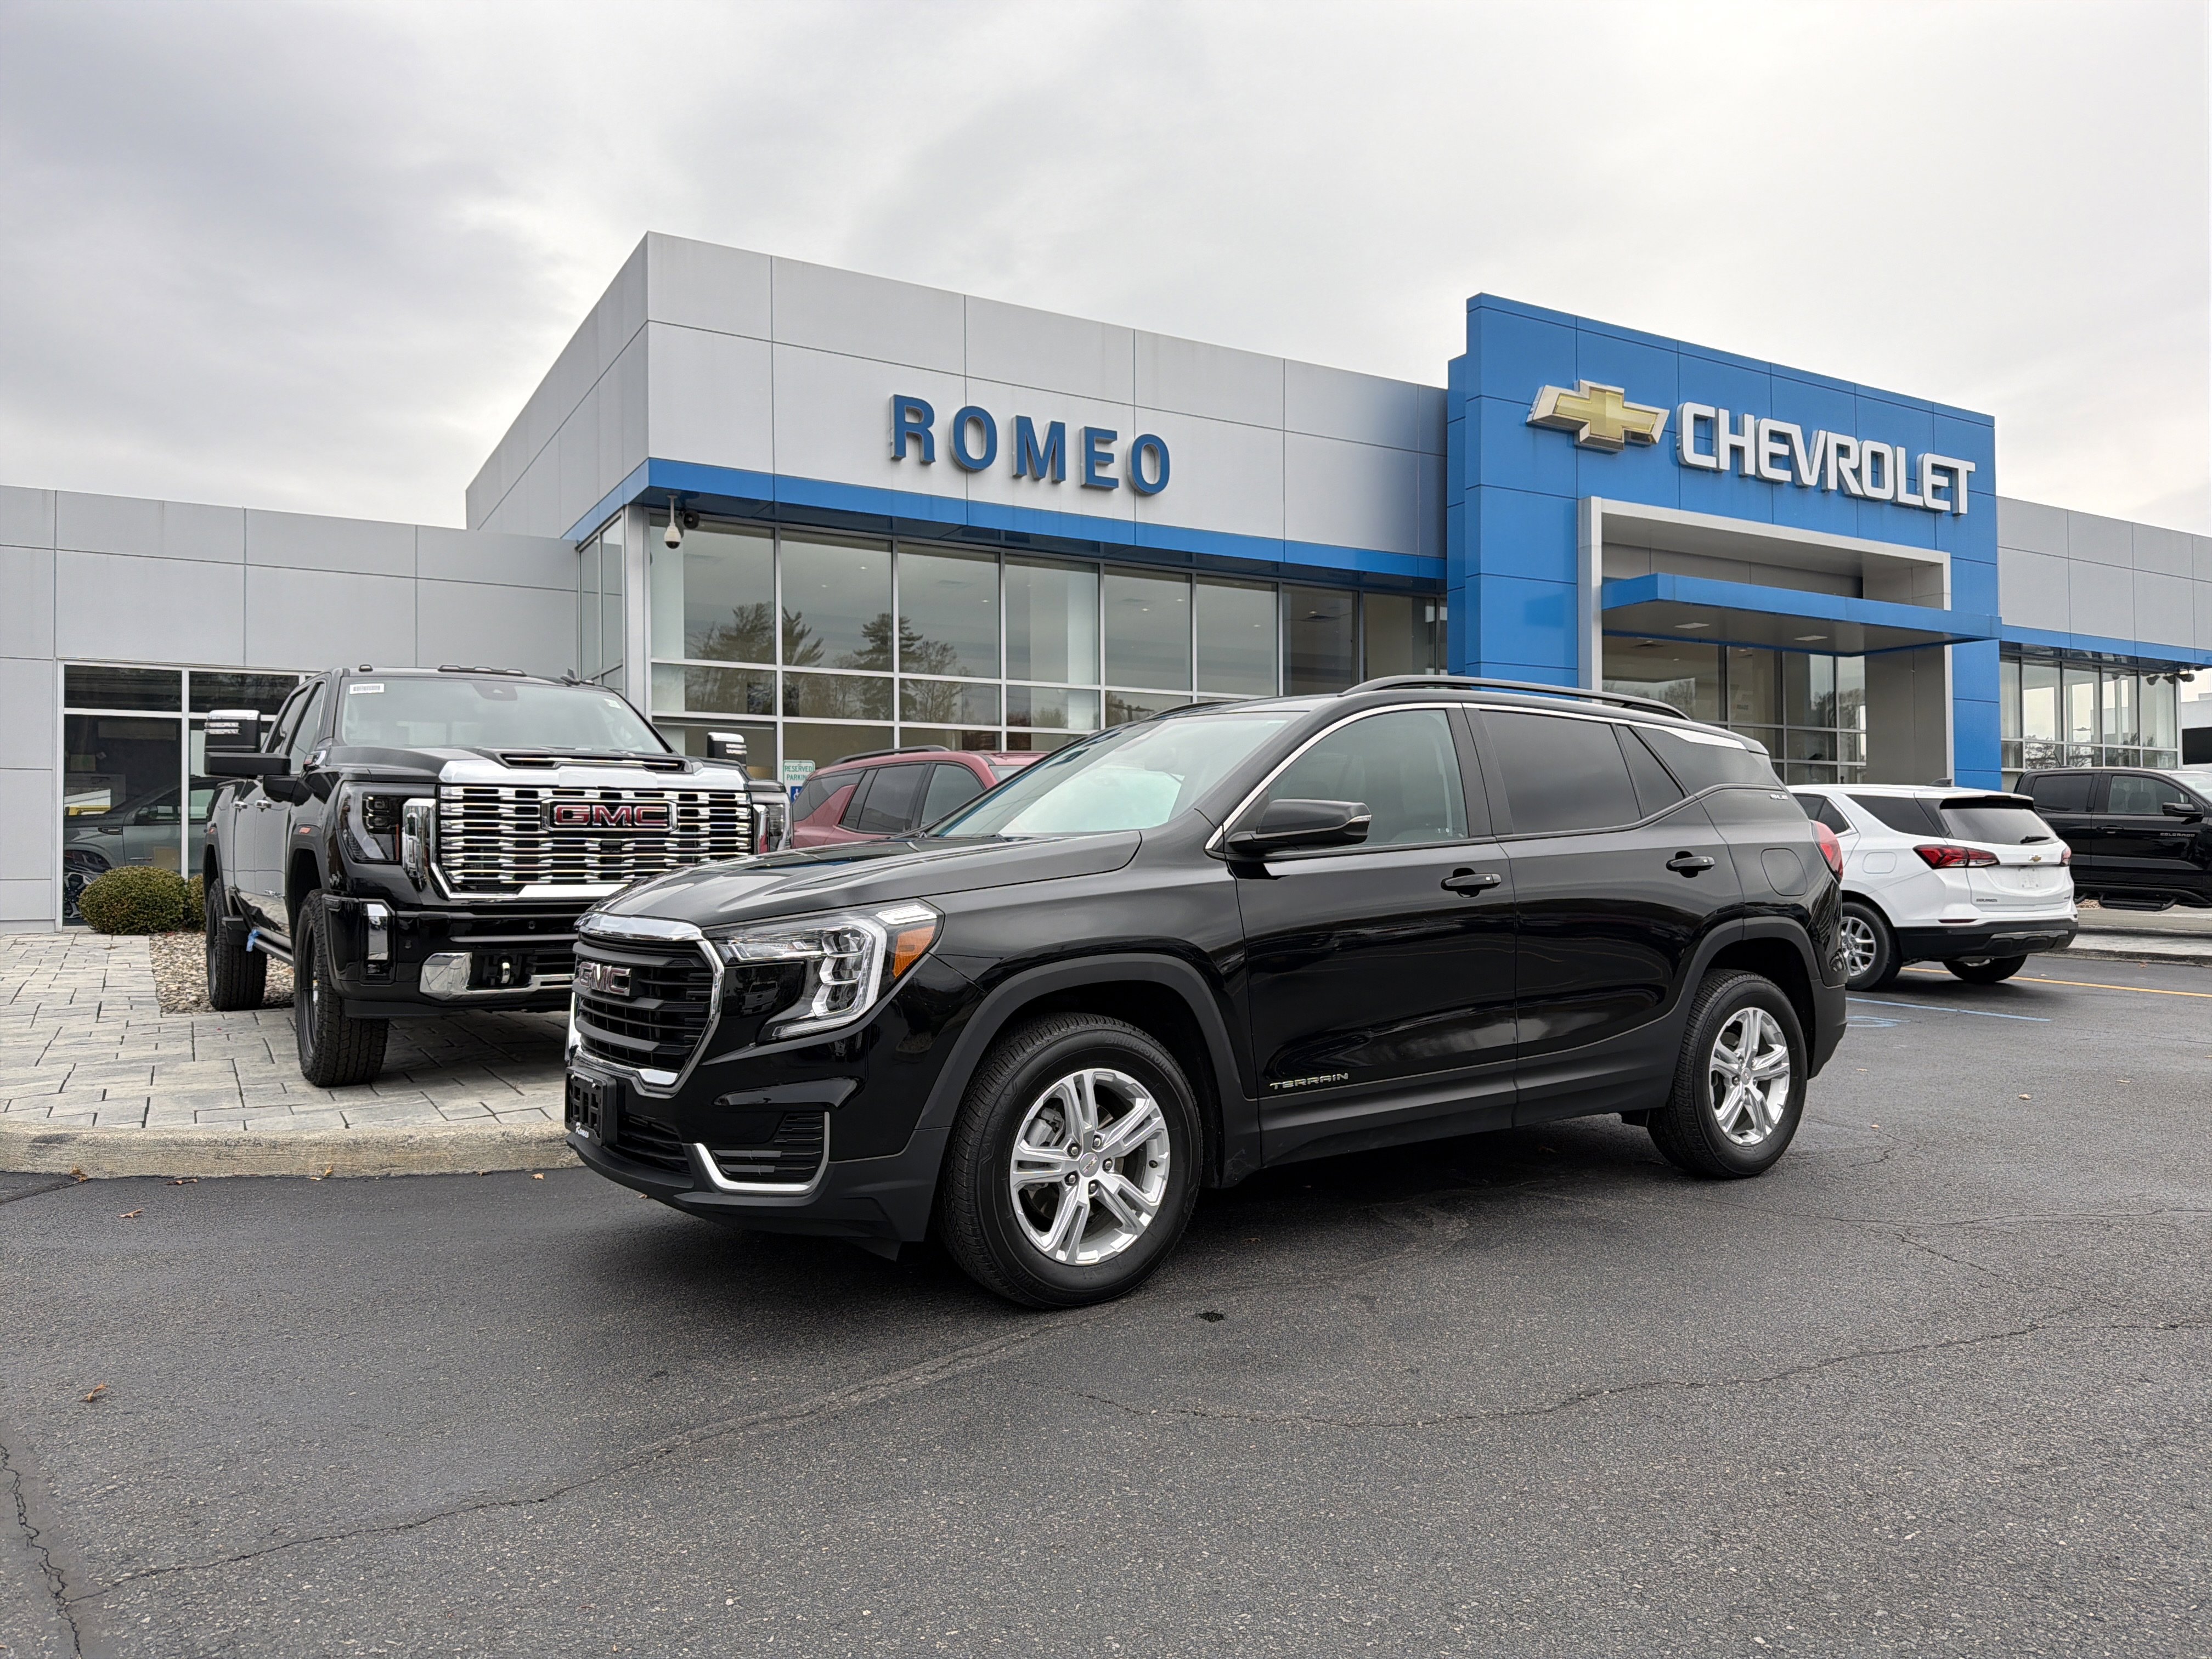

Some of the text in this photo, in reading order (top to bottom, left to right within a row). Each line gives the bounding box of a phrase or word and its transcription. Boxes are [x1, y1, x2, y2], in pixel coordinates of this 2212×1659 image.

[889, 394, 1170, 495] ROMEO
[1676, 402, 1976, 516] CHEVROLET
[554, 804, 668, 826] GMC
[579, 961, 631, 997] GMC
[1269, 1073, 1348, 1090] TERRAIN
